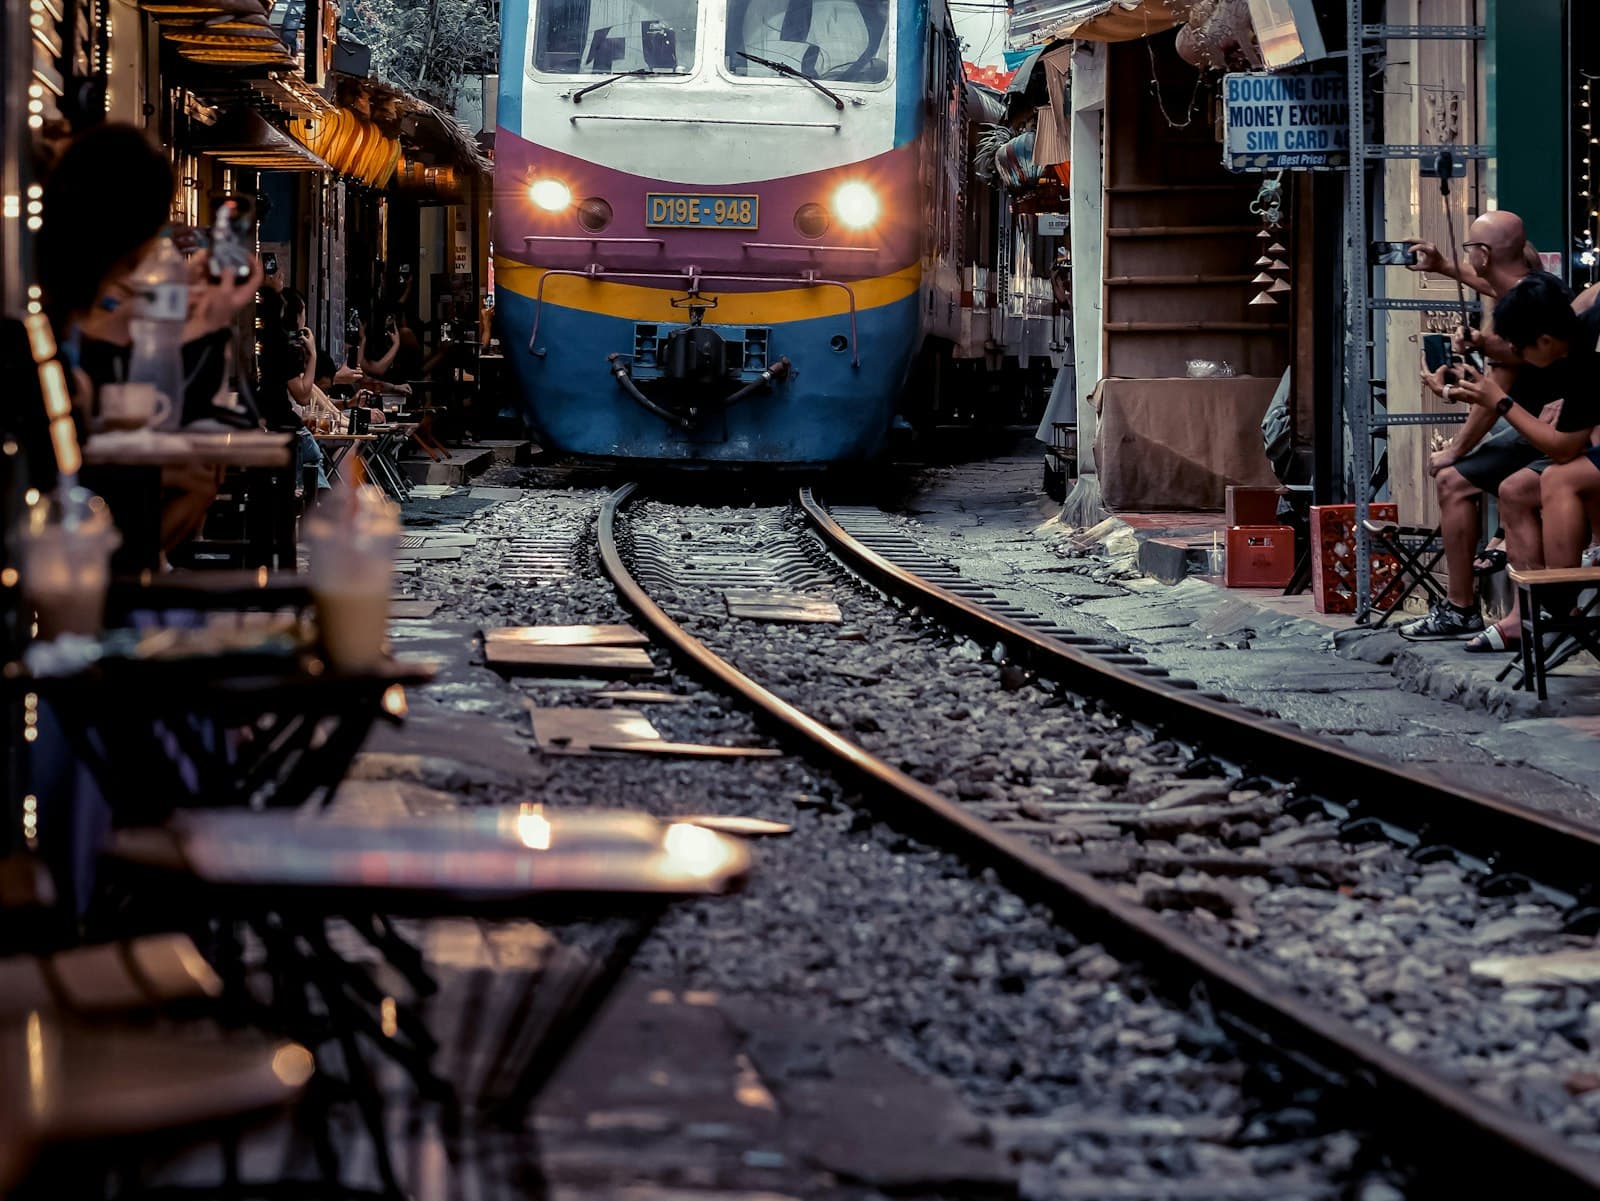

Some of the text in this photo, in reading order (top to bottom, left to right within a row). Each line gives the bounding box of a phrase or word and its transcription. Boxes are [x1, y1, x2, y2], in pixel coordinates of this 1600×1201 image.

[1228, 77, 1349, 102] BOOKING OFFI
[1229, 105, 1284, 127] MONEY
[1246, 131, 1279, 150] SIM
[1284, 130, 1329, 150] CARD
